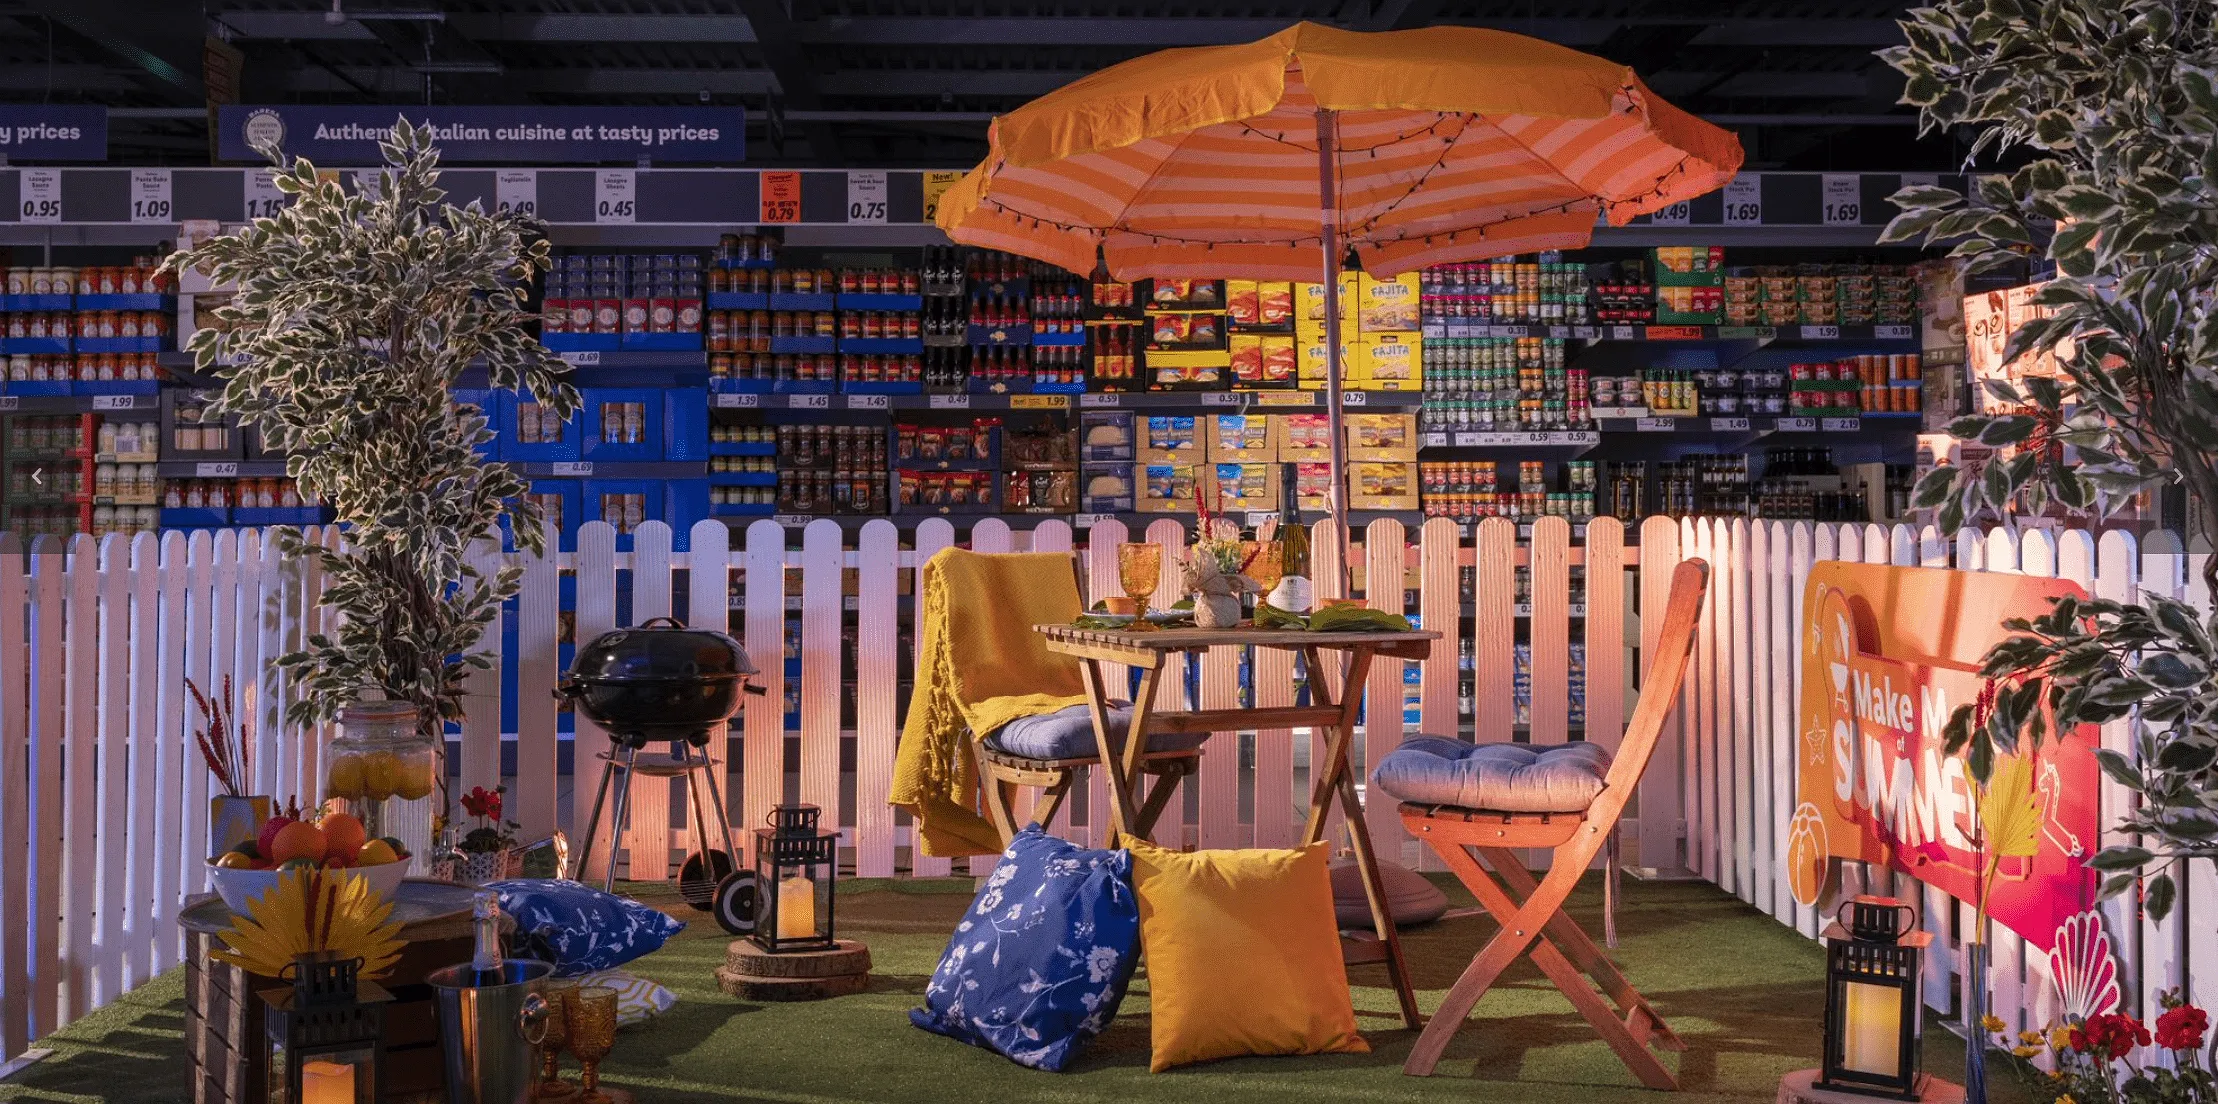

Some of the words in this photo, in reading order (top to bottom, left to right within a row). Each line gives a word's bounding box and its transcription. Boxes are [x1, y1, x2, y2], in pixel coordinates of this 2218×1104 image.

[17, 122, 81, 144] prices
[314, 123, 416, 141] Authen
[428, 123, 490, 141] talian
[495, 123, 566, 141] cuisine
[572, 125, 594, 141] at
[599, 125, 653, 145] tasty
[659, 123, 720, 145] prices
[932, 173, 954, 181] New!
[24, 200, 60, 217] 0.95
[135, 200, 170, 217] 1.09
[499, 201, 534, 216] 049
[598, 200, 634, 217] 0.45
[851, 203, 886, 219] 0.75
[1727, 203, 1760, 221] 1.69
[1825, 203, 1859, 221] 1.69
[768, 208, 795, 221] 0.79
[1371, 284, 1409, 298] FAJITA
[1819, 327, 1837, 337] 1.99
[1372, 344, 1410, 358] FAJITA
[238, 353, 253, 362] 0.9
[111, 397, 133, 407] 1.99
[737, 395, 757, 405] 1.39
[808, 396, 827, 406] 1.45
[867, 396, 886, 406] 1.45
[1046, 396, 1065, 406] 1.99
[1098, 394, 1117, 403] 0.59
[1219, 394, 1238, 403] 0.59
[1344, 393, 1364, 402] 0.79
[1654, 418, 1673, 427] 2.99
[1729, 419, 1747, 429] 1.49
[1796, 418, 1814, 428] 0.79
[1840, 420, 1858, 429] 2.19
[1529, 433, 1548, 442] 0.59
[1567, 432, 1586, 441] 0.59
[216, 464, 236, 473] 0.47
[729, 597, 746, 606] 0.8
[1852, 668, 1914, 733] Make
